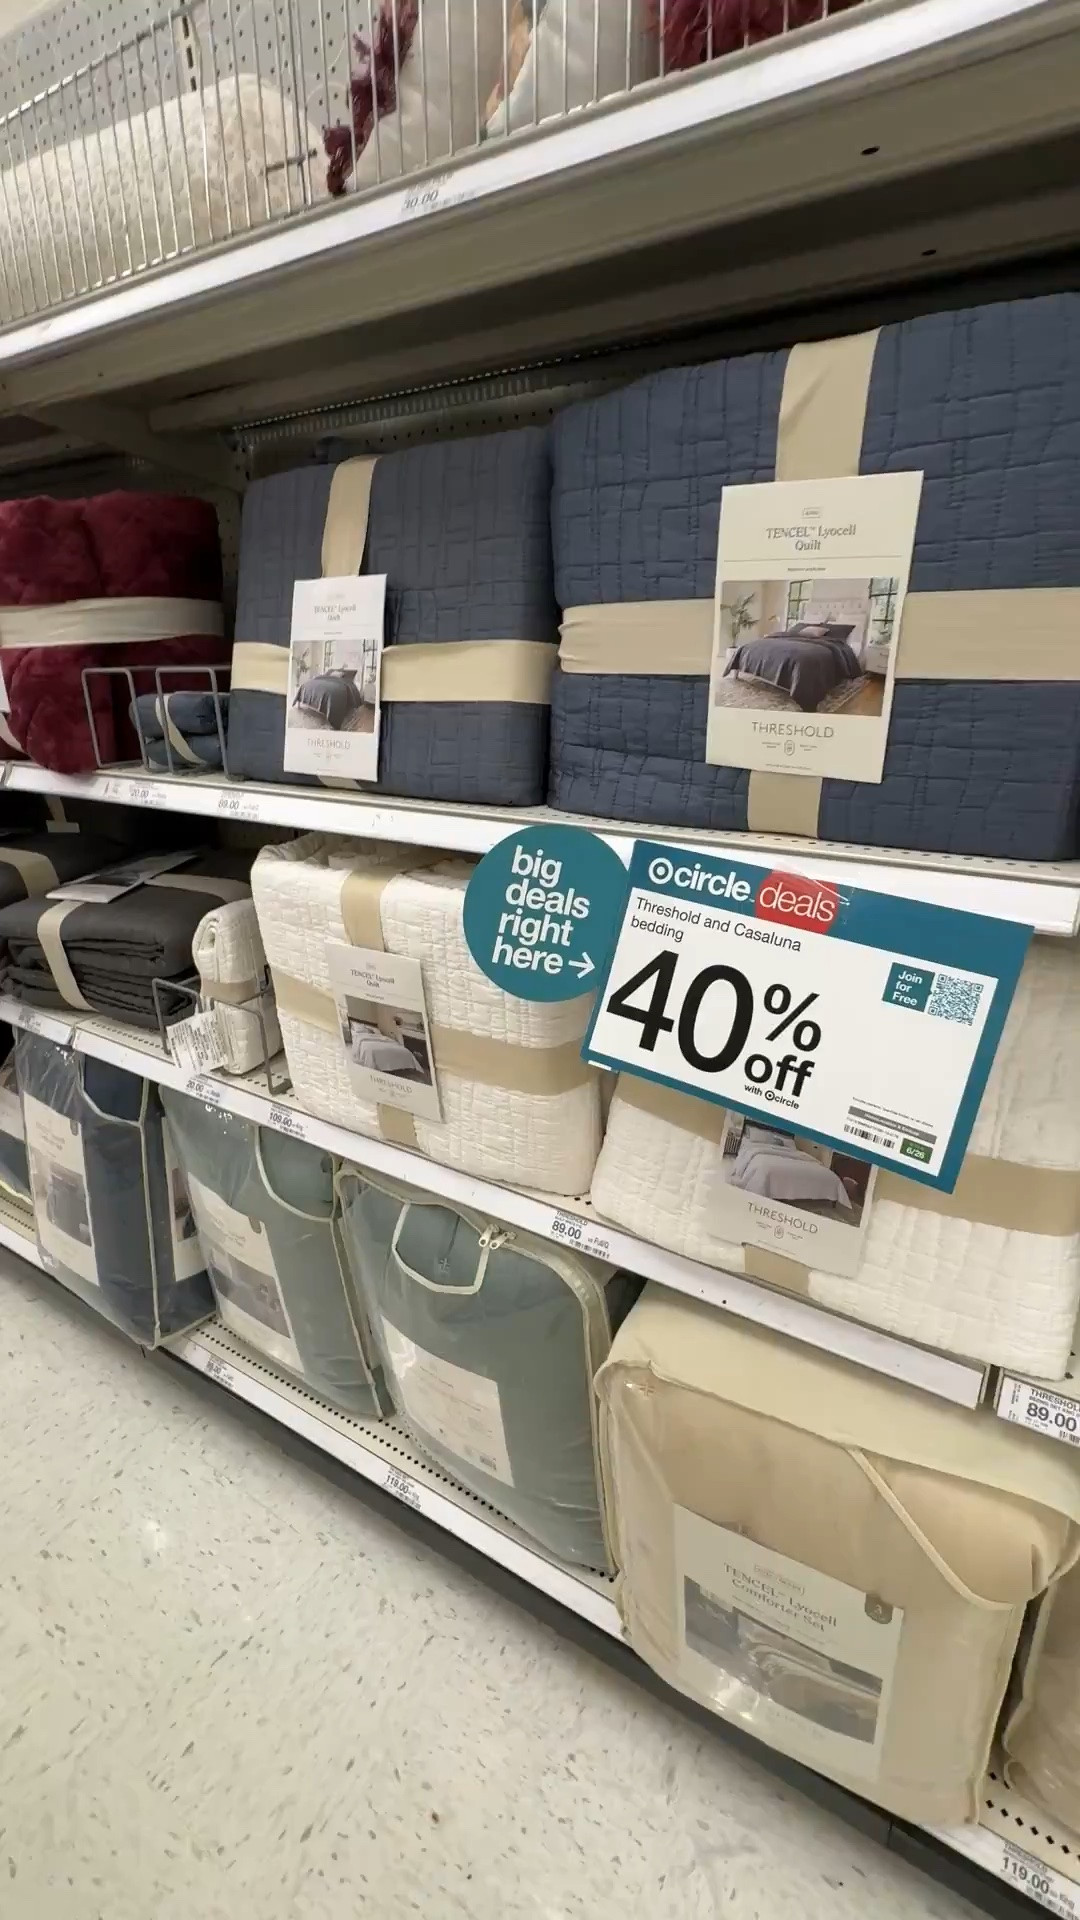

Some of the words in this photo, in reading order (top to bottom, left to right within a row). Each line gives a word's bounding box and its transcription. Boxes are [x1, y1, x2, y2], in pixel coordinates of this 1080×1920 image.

[795, 540, 821, 550] Quilt
[818, 524, 857, 539] Lyocell
[307, 738, 351, 749] THRESHOLD
[752, 721, 834, 738] THRESHOLD
[511, 845, 563, 888] big
[505, 878, 591, 919] deals
[759, 881, 836, 922] deals
[498, 908, 574, 947] right
[631, 915, 684, 943] bedding
[636, 896, 702, 925] Threshold
[703, 916, 731, 933] and
[734, 922, 802, 952] Casaluna
[492, 936, 563, 974] here
[896, 982, 913, 993] for
[898, 970, 923, 985] Join
[892, 991, 918, 1007] Free
[744, 1053, 816, 1097] off
[744, 1083, 763, 1097] with
[774, 1094, 800, 1110] circle
[552, 1220, 582, 1240] 89.00
[748, 1202, 818, 1234] THRESHOLD
[1031, 1388, 1080, 1414] THRESHOL
[1027, 1402, 1077, 1432] 89.00
[1003, 1856, 1049, 1894] 119.00
